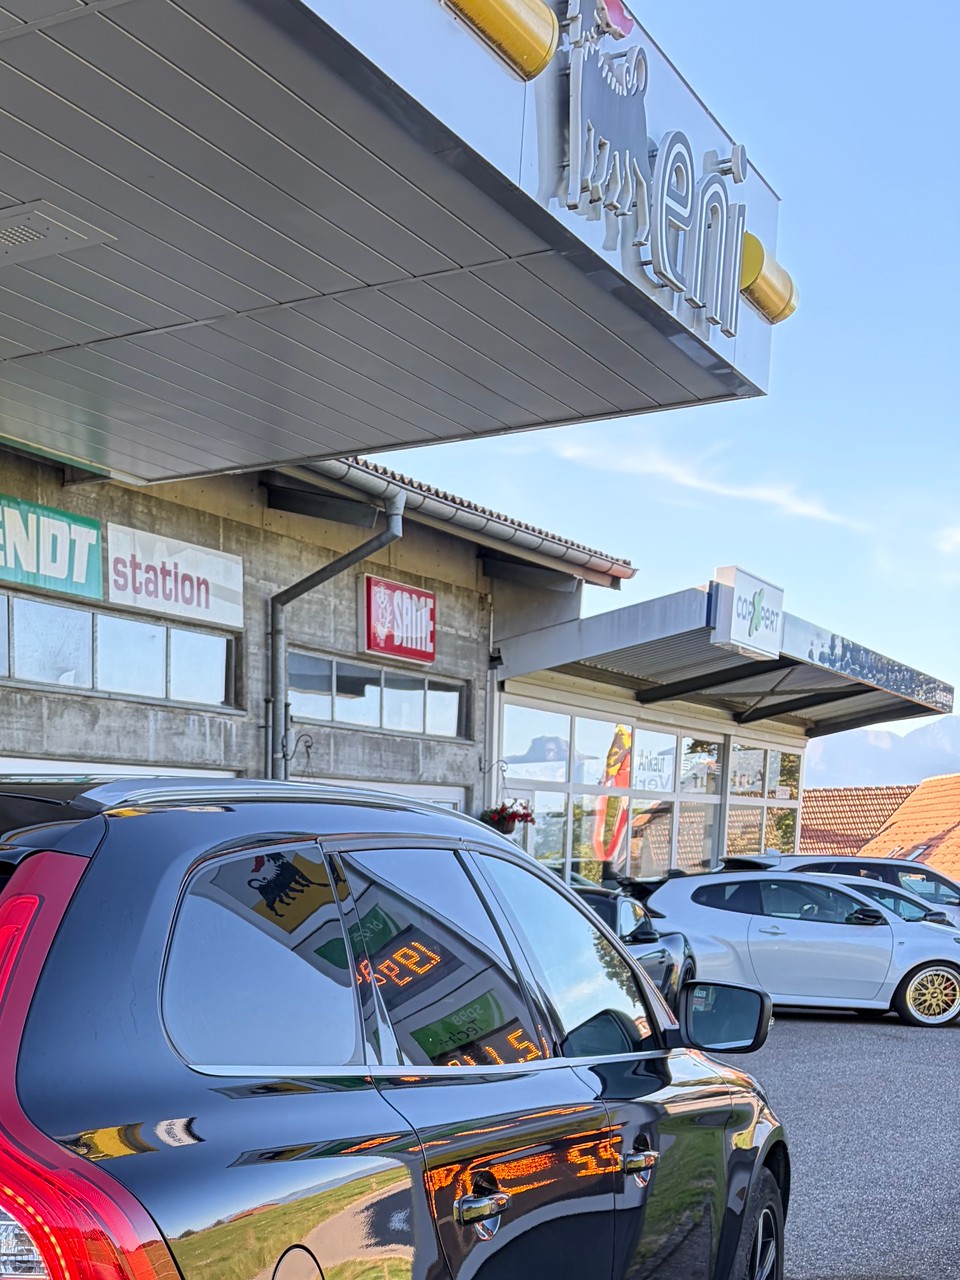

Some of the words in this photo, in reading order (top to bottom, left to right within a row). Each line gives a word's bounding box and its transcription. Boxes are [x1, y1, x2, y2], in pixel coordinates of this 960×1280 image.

[651, 130, 747, 338] eni
[113, 553, 211, 609] station
[393, 590, 434, 653] SAME
